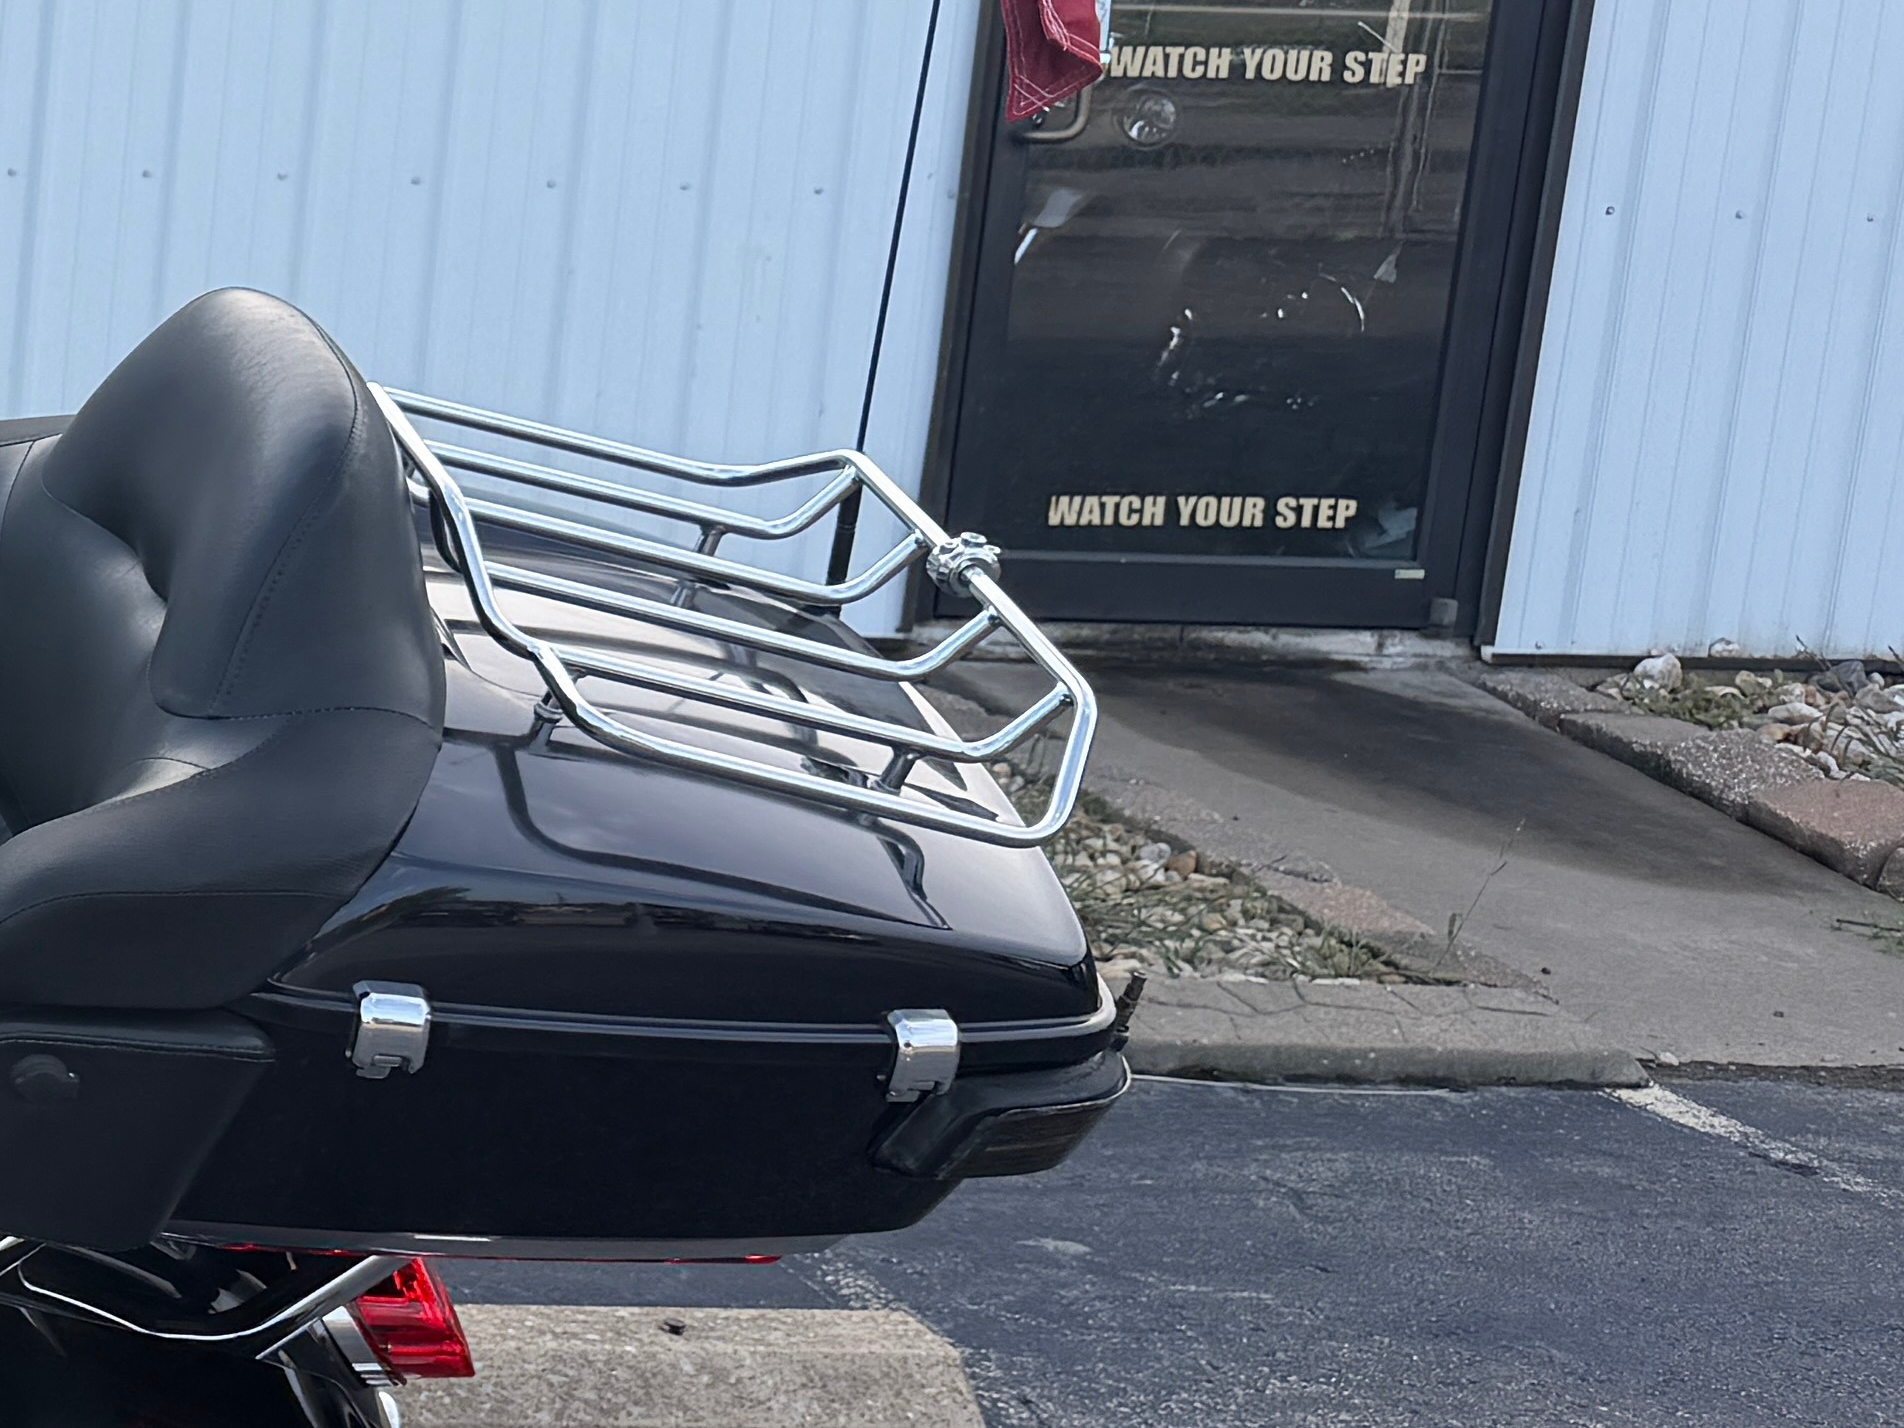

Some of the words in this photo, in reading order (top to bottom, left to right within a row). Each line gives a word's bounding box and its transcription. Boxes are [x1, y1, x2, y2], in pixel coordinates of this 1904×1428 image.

[1110, 45, 1232, 79] WATCH
[1243, 47, 1334, 82] YOUR
[1343, 50, 1428, 86] STEP
[1047, 494, 1167, 527] WATCH
[1176, 495, 1266, 528] YOUR
[1275, 497, 1359, 529] STEP
